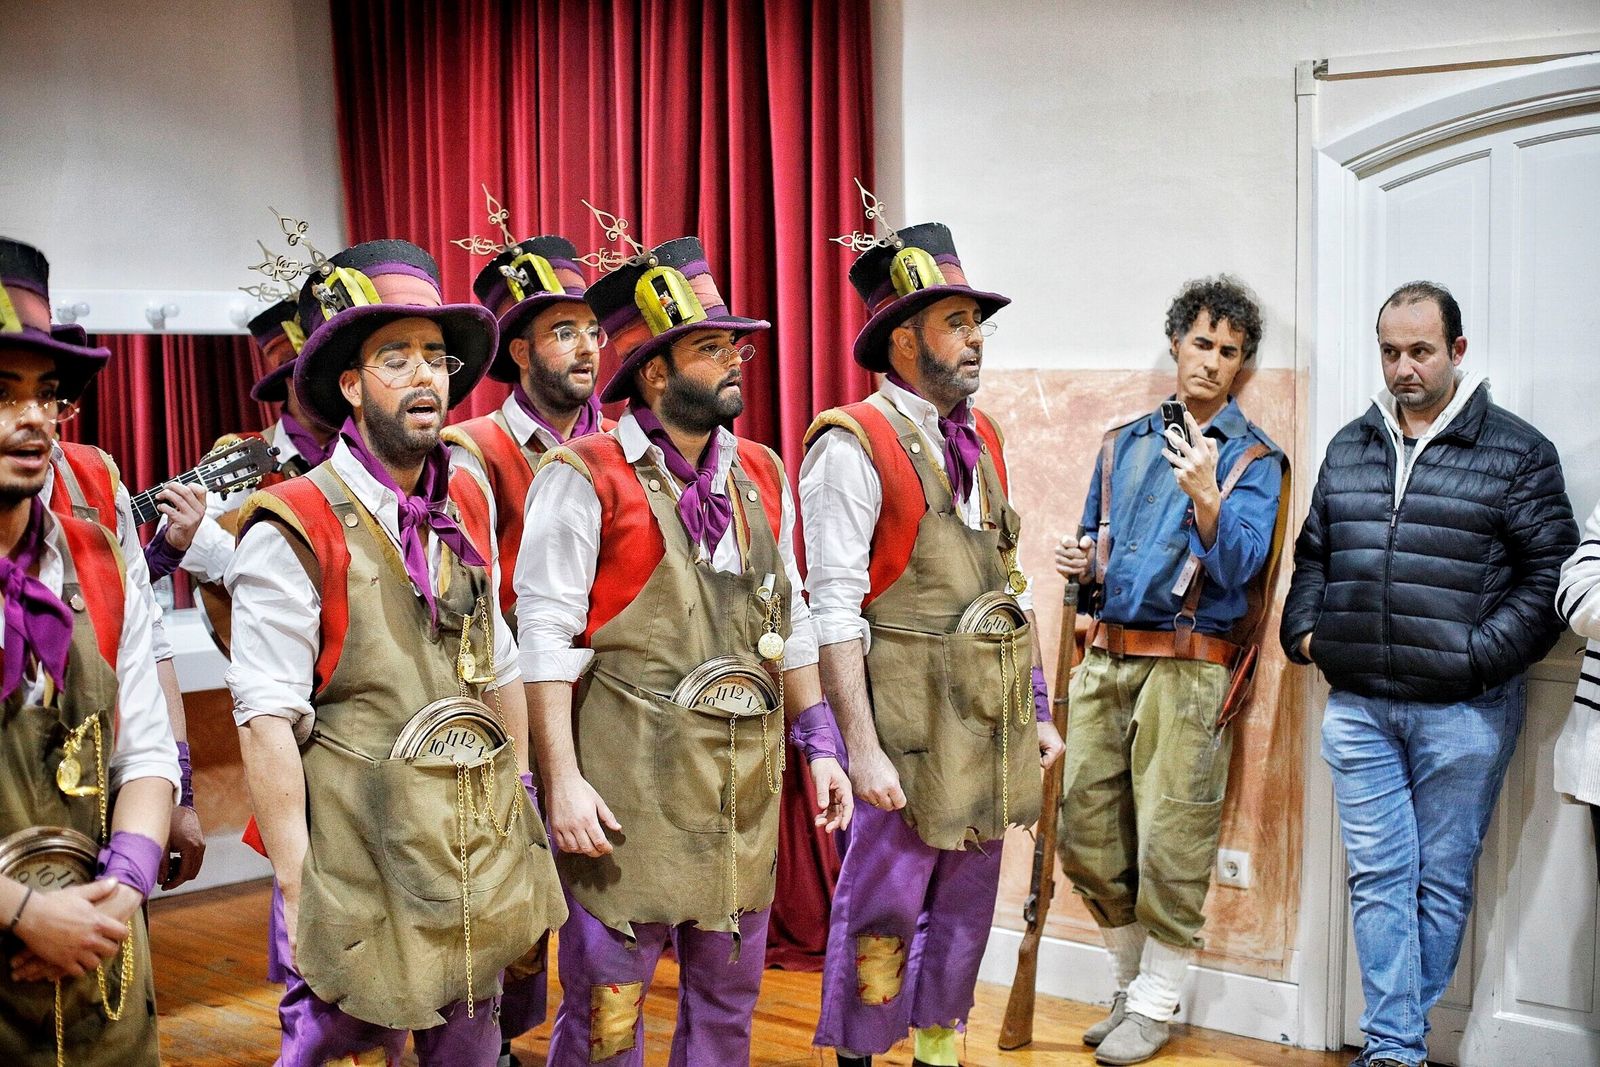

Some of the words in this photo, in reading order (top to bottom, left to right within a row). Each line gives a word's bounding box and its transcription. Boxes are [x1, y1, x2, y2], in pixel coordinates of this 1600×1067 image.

[702, 695, 716, 707] 10
[715, 686, 728, 701] 11
[729, 684, 744, 700] 12
[746, 695, 753, 709] 1
[428, 738, 445, 756] 10
[445, 729, 459, 747] 11
[460, 731, 476, 749] 12
[477, 745, 485, 758] 1
[36, 864, 55, 887] 10
